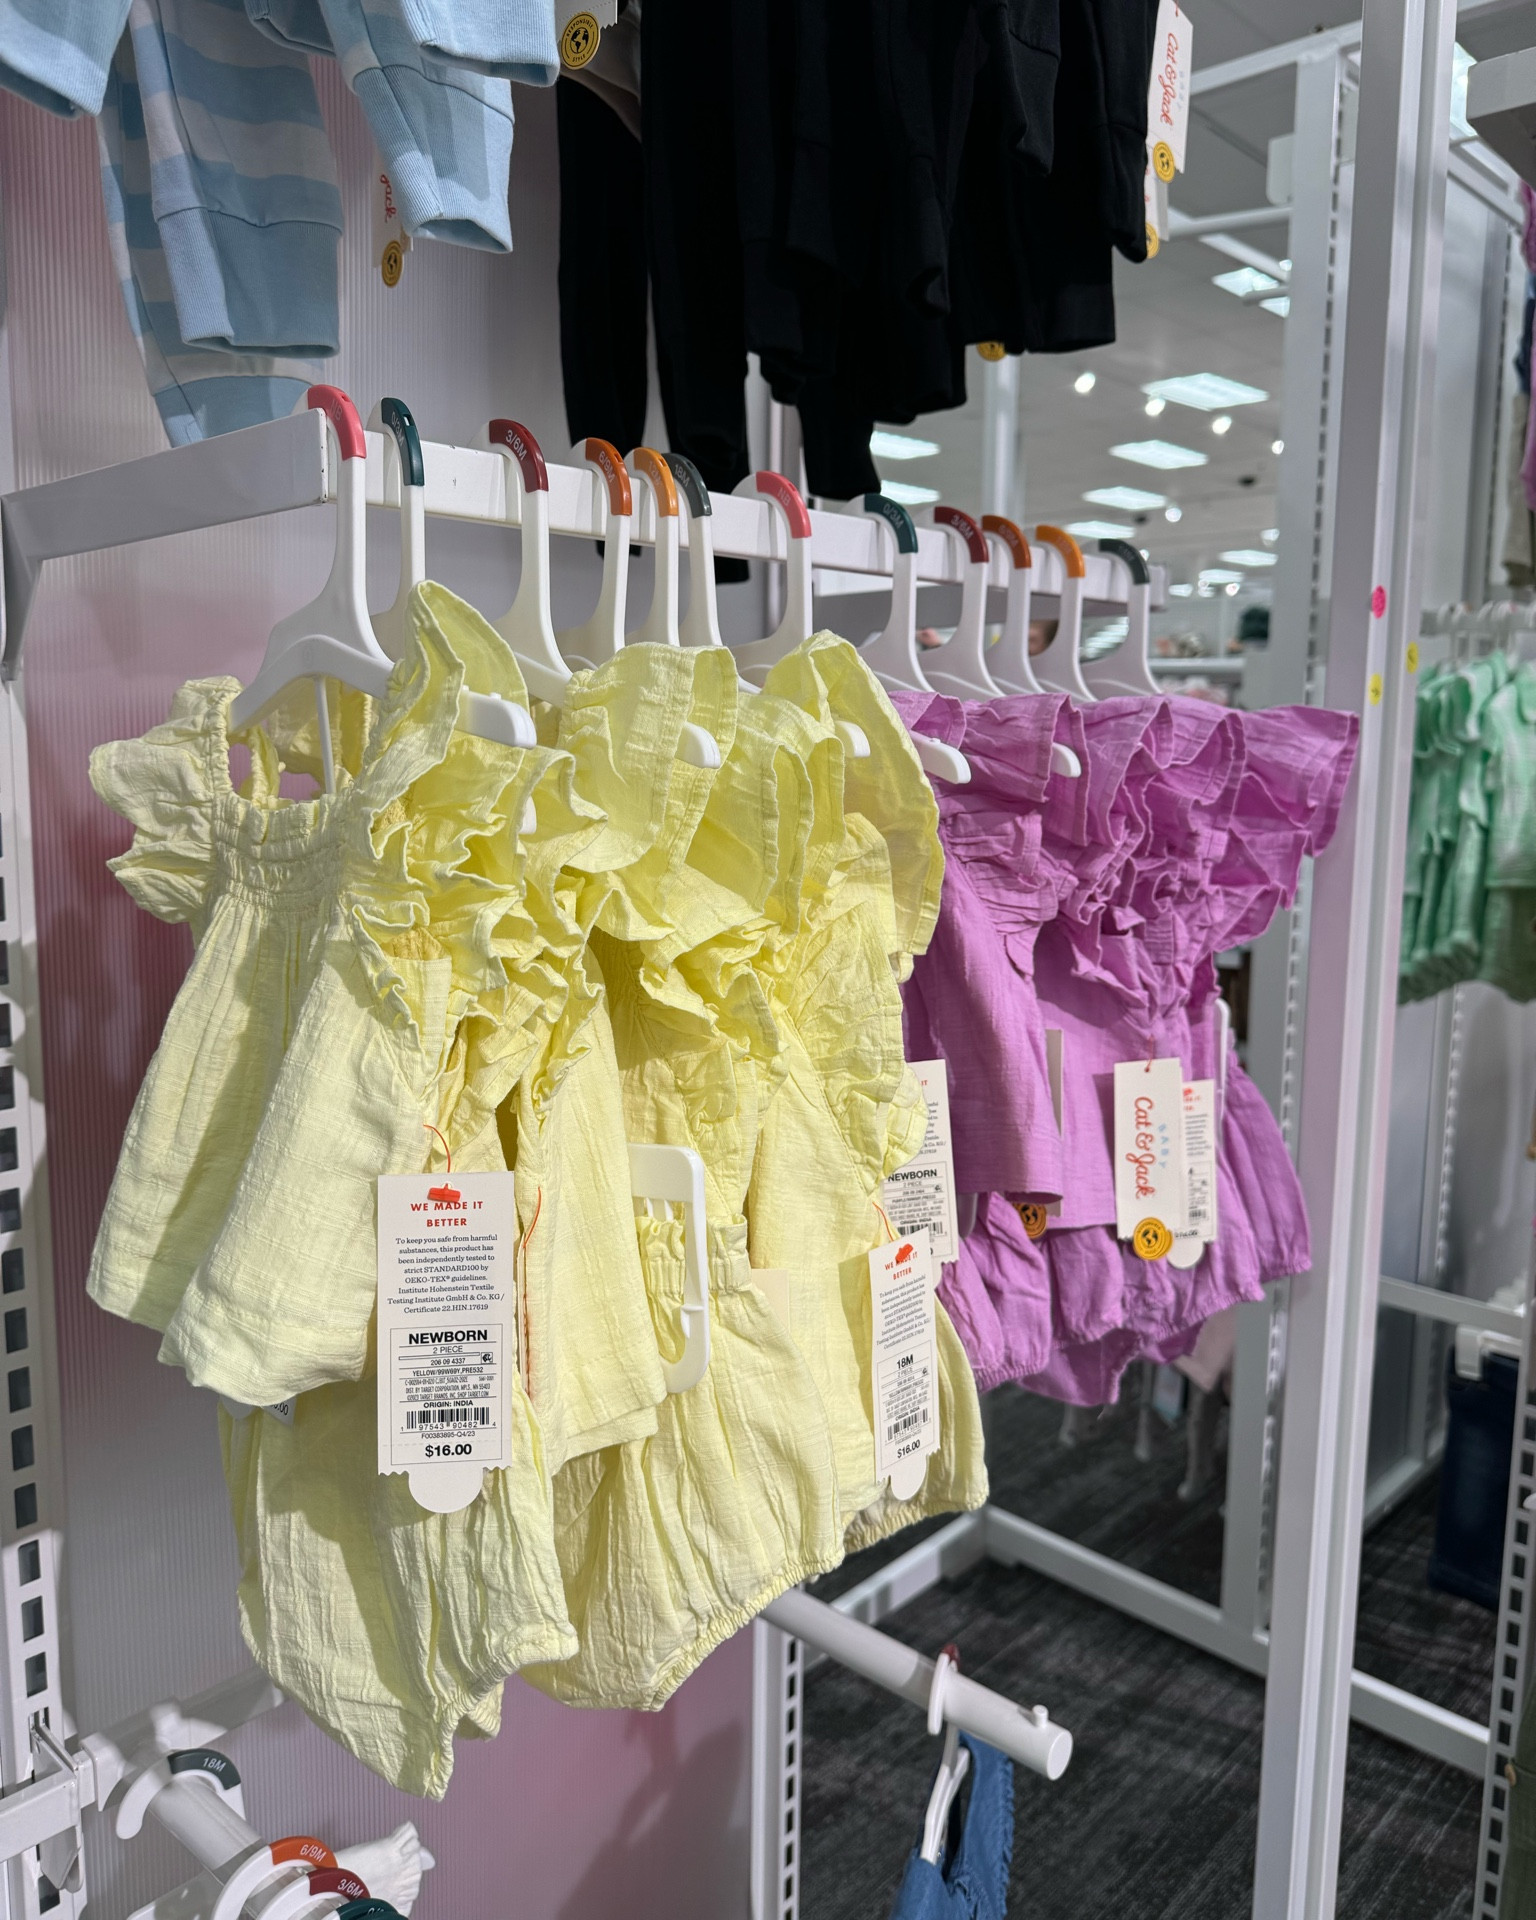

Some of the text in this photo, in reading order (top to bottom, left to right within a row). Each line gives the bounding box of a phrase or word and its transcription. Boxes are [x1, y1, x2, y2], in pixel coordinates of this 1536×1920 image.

[567, 18, 594, 37] RESPONSIBLE
[1166, 32, 1179, 64] Cat
[1165, 64, 1177, 85] &
[1158, 74, 1177, 127] Jack
[506, 430, 528, 461] 3/6M
[599, 451, 616, 482] 6/9M
[675, 464, 691, 487] 18M
[777, 487, 791, 506] NB
[883, 504, 904, 529] 0/3M
[1126, 1097, 1156, 1200] Cat & Jack
[888, 1169, 937, 1182] NEWBORN
[411, 1201, 484, 1211] WE MADE IT
[426, 1218, 467, 1227] BETTER
[406, 1237, 423, 1245] keep
[424, 1237, 436, 1245] you
[454, 1245, 481, 1253] product
[416, 1256, 465, 1264] independently
[885, 1262, 894, 1271] WE
[424, 1265, 479, 1273] STANDARD100
[893, 1267, 912, 1280] BETTER
[405, 1276, 450, 1284] OEKO-TEX®
[430, 1285, 469, 1293] Hohenstein
[446, 1294, 468, 1302] GmbH
[404, 1306, 440, 1314] Certificate
[409, 1330, 488, 1344] NEWBORN
[440, 1345, 463, 1353] PIECE
[897, 1354, 914, 1369] 18M
[424, 1401, 452, 1409] ORIGIN:
[419, 1423, 445, 1431] 97543
[452, 1421, 478, 1429] 90482
[425, 1443, 472, 1458] $16.00
[897, 1439, 921, 1459] $16.00
[203, 1757, 227, 1773] 18M
[300, 1844, 327, 1862] 6/9M
[338, 1879, 364, 1899] 3/6M
